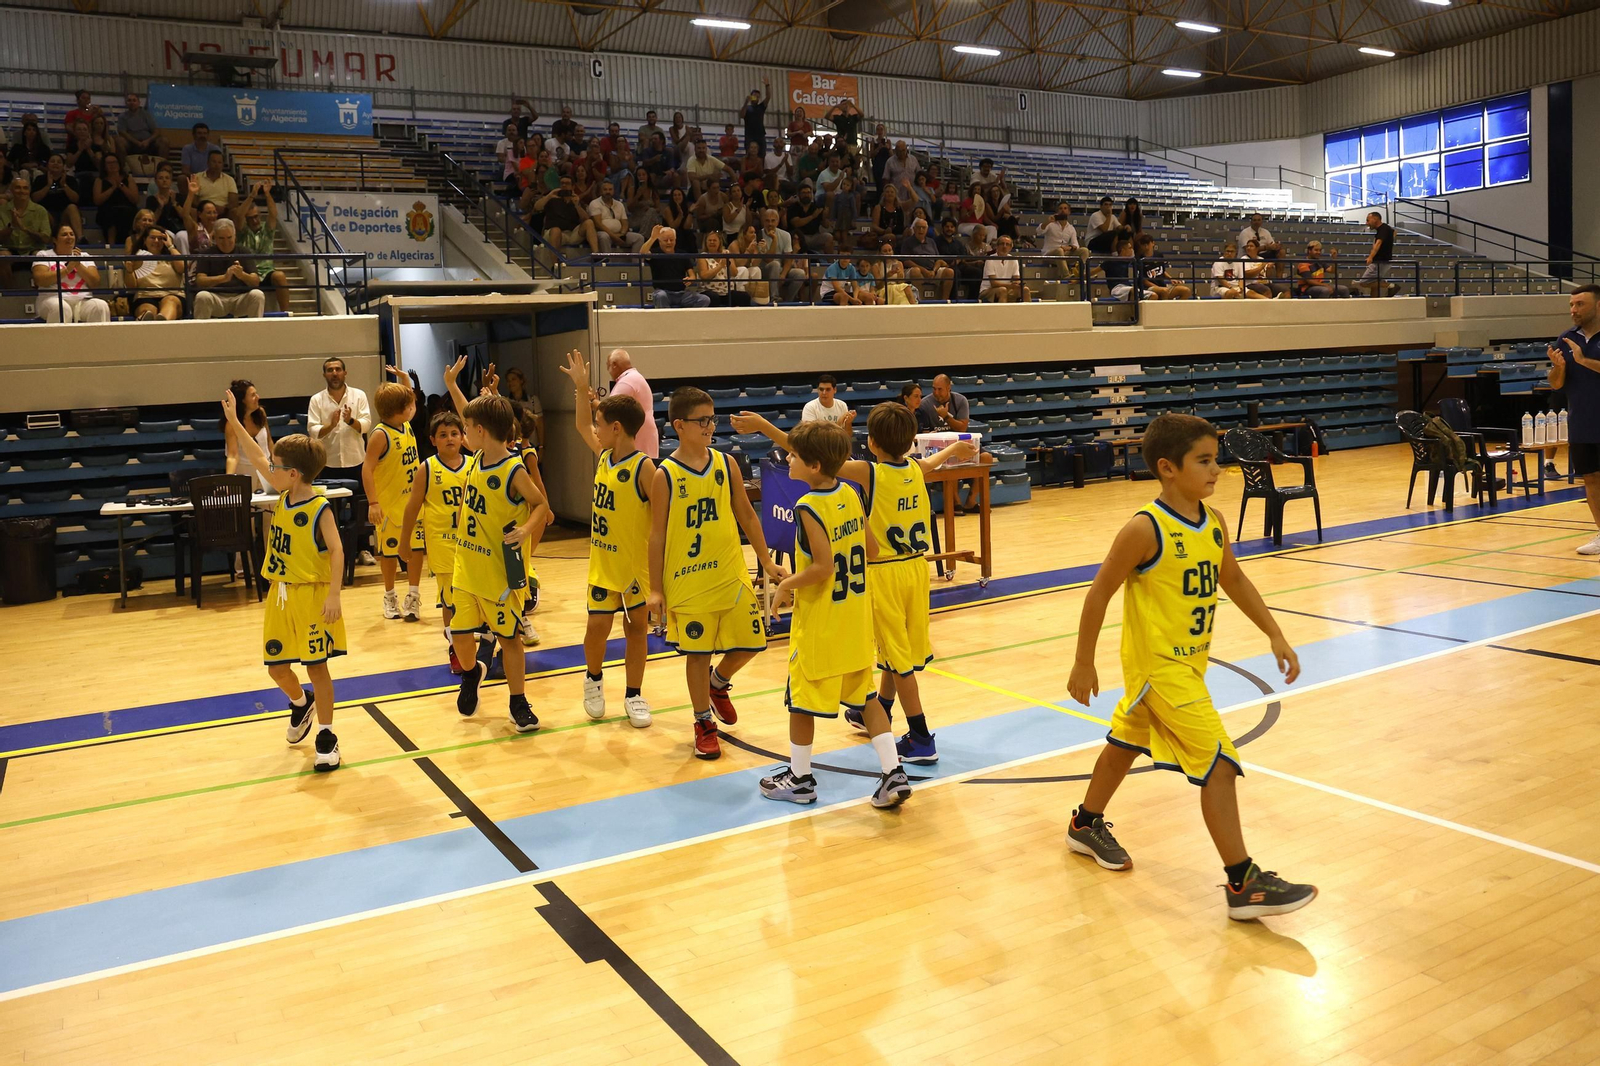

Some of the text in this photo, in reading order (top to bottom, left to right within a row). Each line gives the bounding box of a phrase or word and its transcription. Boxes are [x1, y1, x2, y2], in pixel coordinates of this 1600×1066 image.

[592, 60, 603, 78] C
[811, 74, 837, 90] Bar
[154, 102, 204, 111] Ayuntamiento
[1019, 93, 1027, 110] D
[164, 110, 204, 119] Algeciras
[261, 107, 307, 116] Ayuntamiento
[270, 114, 308, 124] Algeciras
[333, 206, 398, 220] Delegación
[331, 221, 402, 235] de Deportes
[377, 251, 388, 260] de
[390, 250, 434, 263] Algeciras
[442, 486, 463, 506] CB
[897, 494, 919, 512] ALE
[467, 515, 476, 537] 2
[267, 553, 287, 576] 57
[832, 544, 866, 602] 39
[497, 611, 505, 625] 2
[1189, 604, 1216, 635] 37
[752, 619, 760, 634] 9
[308, 637, 325, 654] 57
